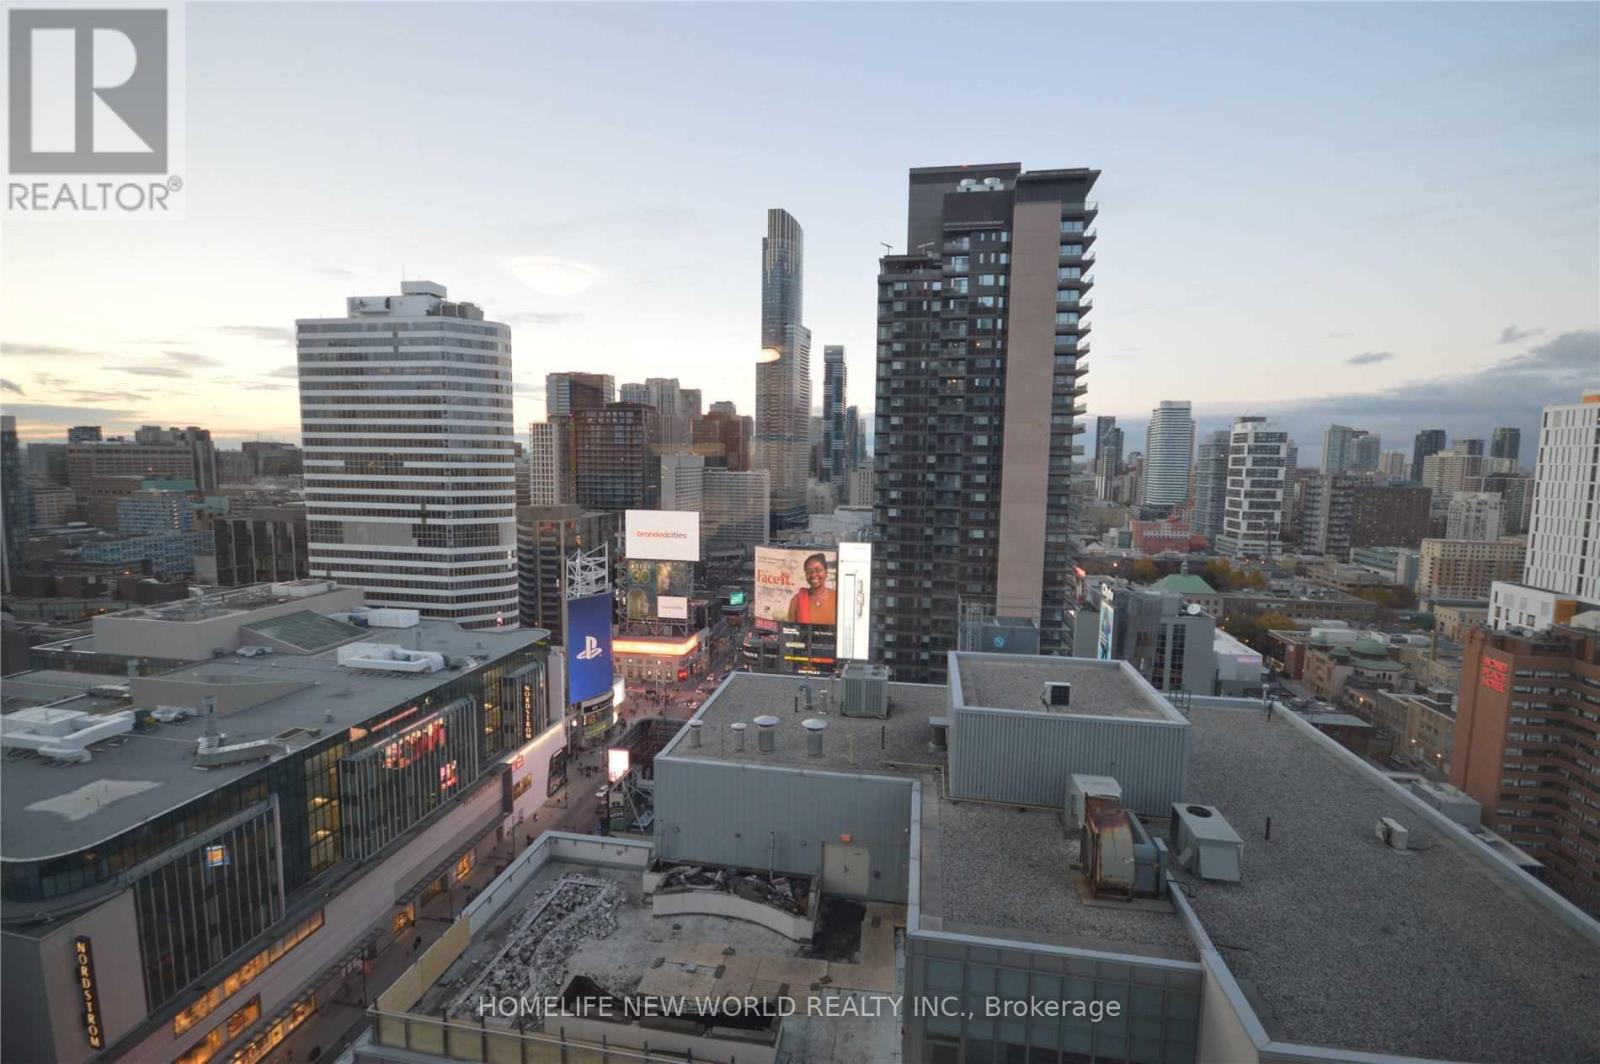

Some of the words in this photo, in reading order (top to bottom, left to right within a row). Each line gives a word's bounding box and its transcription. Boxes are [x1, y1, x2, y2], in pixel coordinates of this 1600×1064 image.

[636, 530, 688, 539] brandedcities
[524, 685, 533, 739] NORDSTROM
[77, 942, 99, 1046] NORDSTROM
